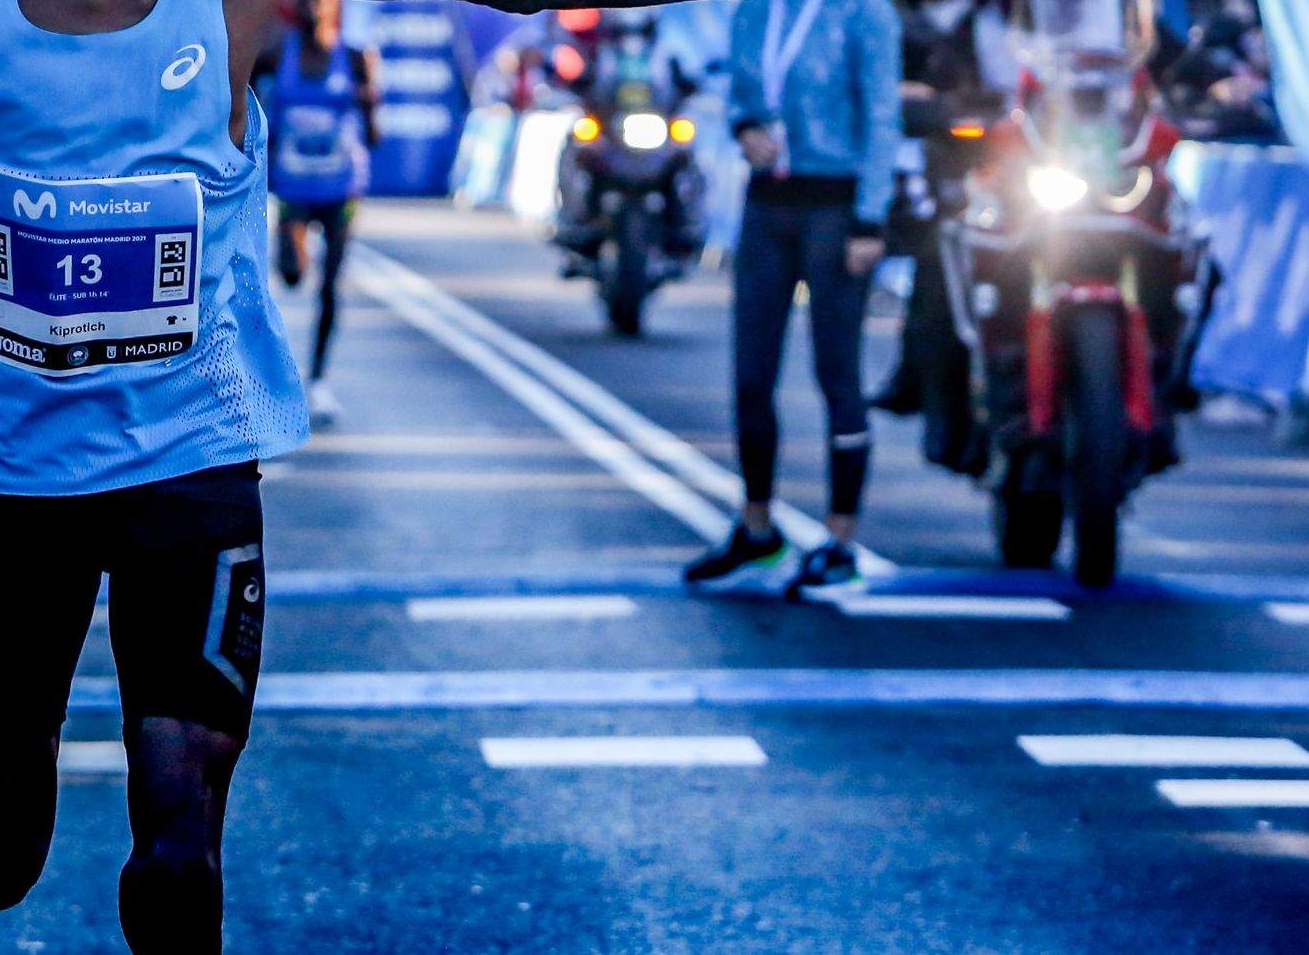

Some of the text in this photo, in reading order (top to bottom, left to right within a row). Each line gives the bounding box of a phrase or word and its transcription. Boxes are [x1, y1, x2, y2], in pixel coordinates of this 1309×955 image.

[69, 198, 151, 216] Movistar
[17, 230, 47, 243] MOVISTAR
[47, 237, 70, 245] MEDIO
[104, 235, 131, 243] MADRID
[56, 253, 103, 286] 13
[49, 321, 106, 339] Kiprotich
[125, 341, 183, 356] MADRID
